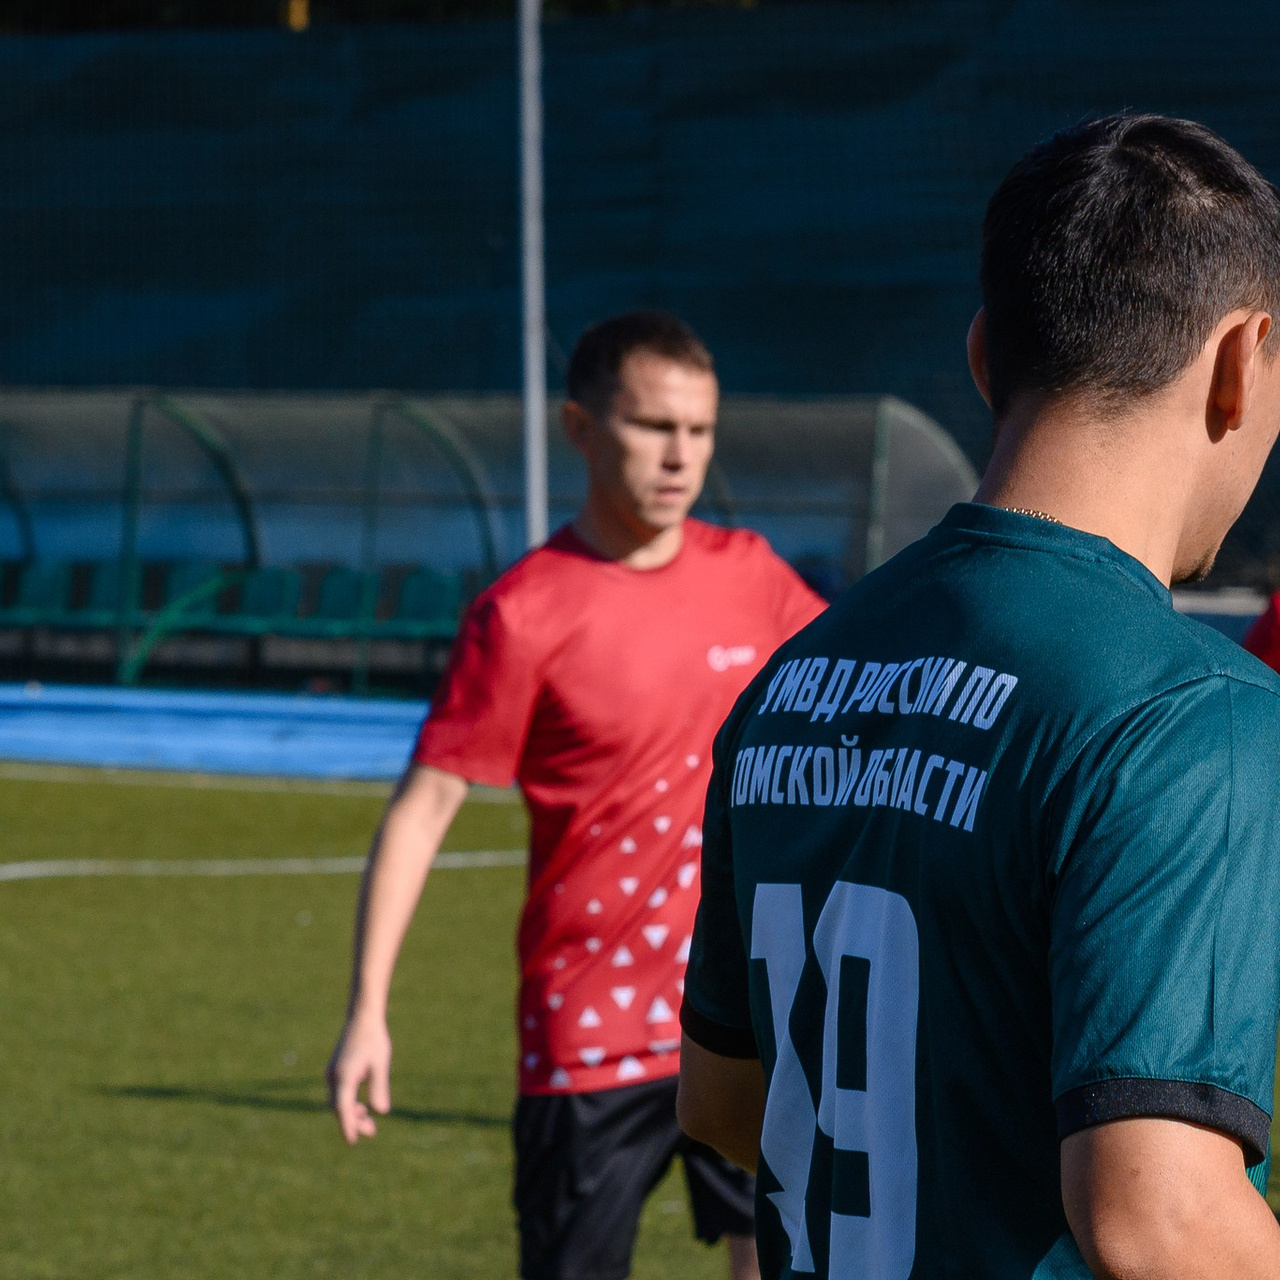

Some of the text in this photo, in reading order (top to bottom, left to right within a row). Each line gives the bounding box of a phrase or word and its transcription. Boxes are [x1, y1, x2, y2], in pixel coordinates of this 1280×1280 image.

[758, 656, 1018, 730] УМВД РОССИИ ПО
[853, 747, 987, 832] ОБЛАСТИ
